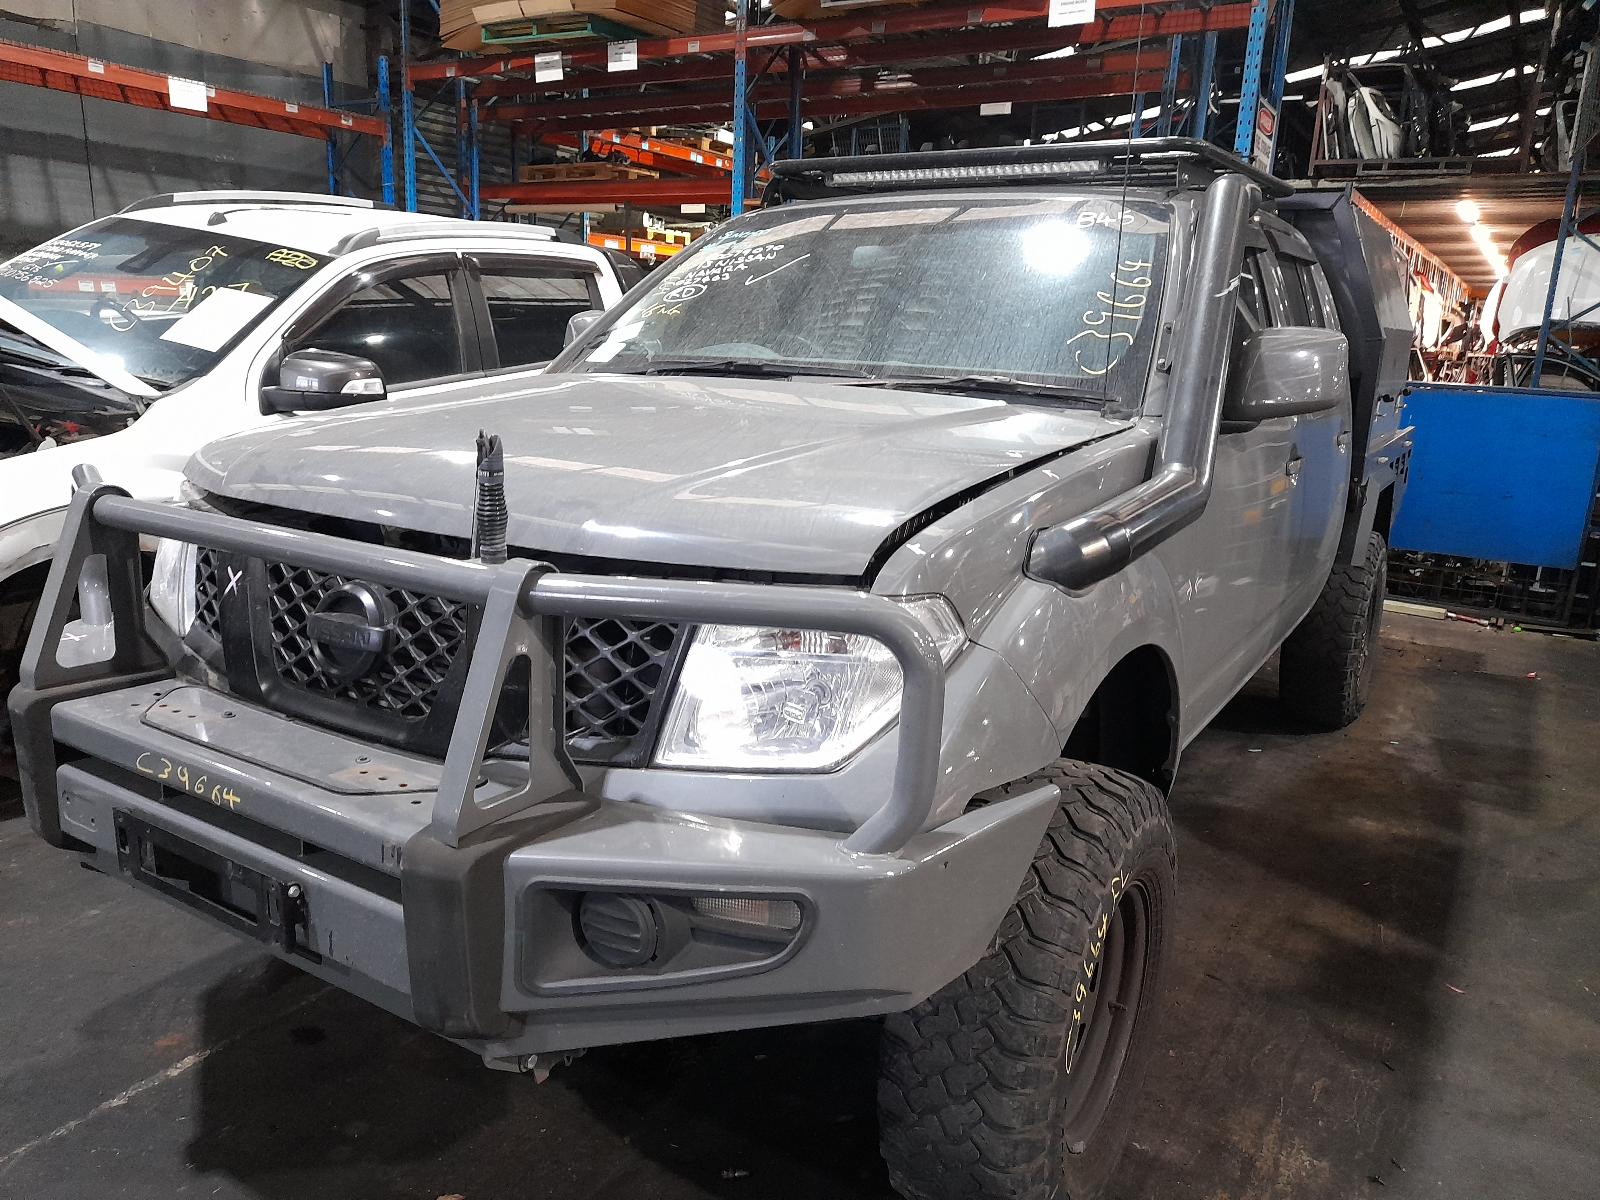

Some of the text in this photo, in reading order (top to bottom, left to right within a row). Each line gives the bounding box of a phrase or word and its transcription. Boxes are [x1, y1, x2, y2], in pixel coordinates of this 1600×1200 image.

[684, 263, 749, 281] NAVARA
[715, 251, 777, 268] NISSAN
[1066, 258, 1153, 375] C39664
[136, 751, 241, 810] C39664
